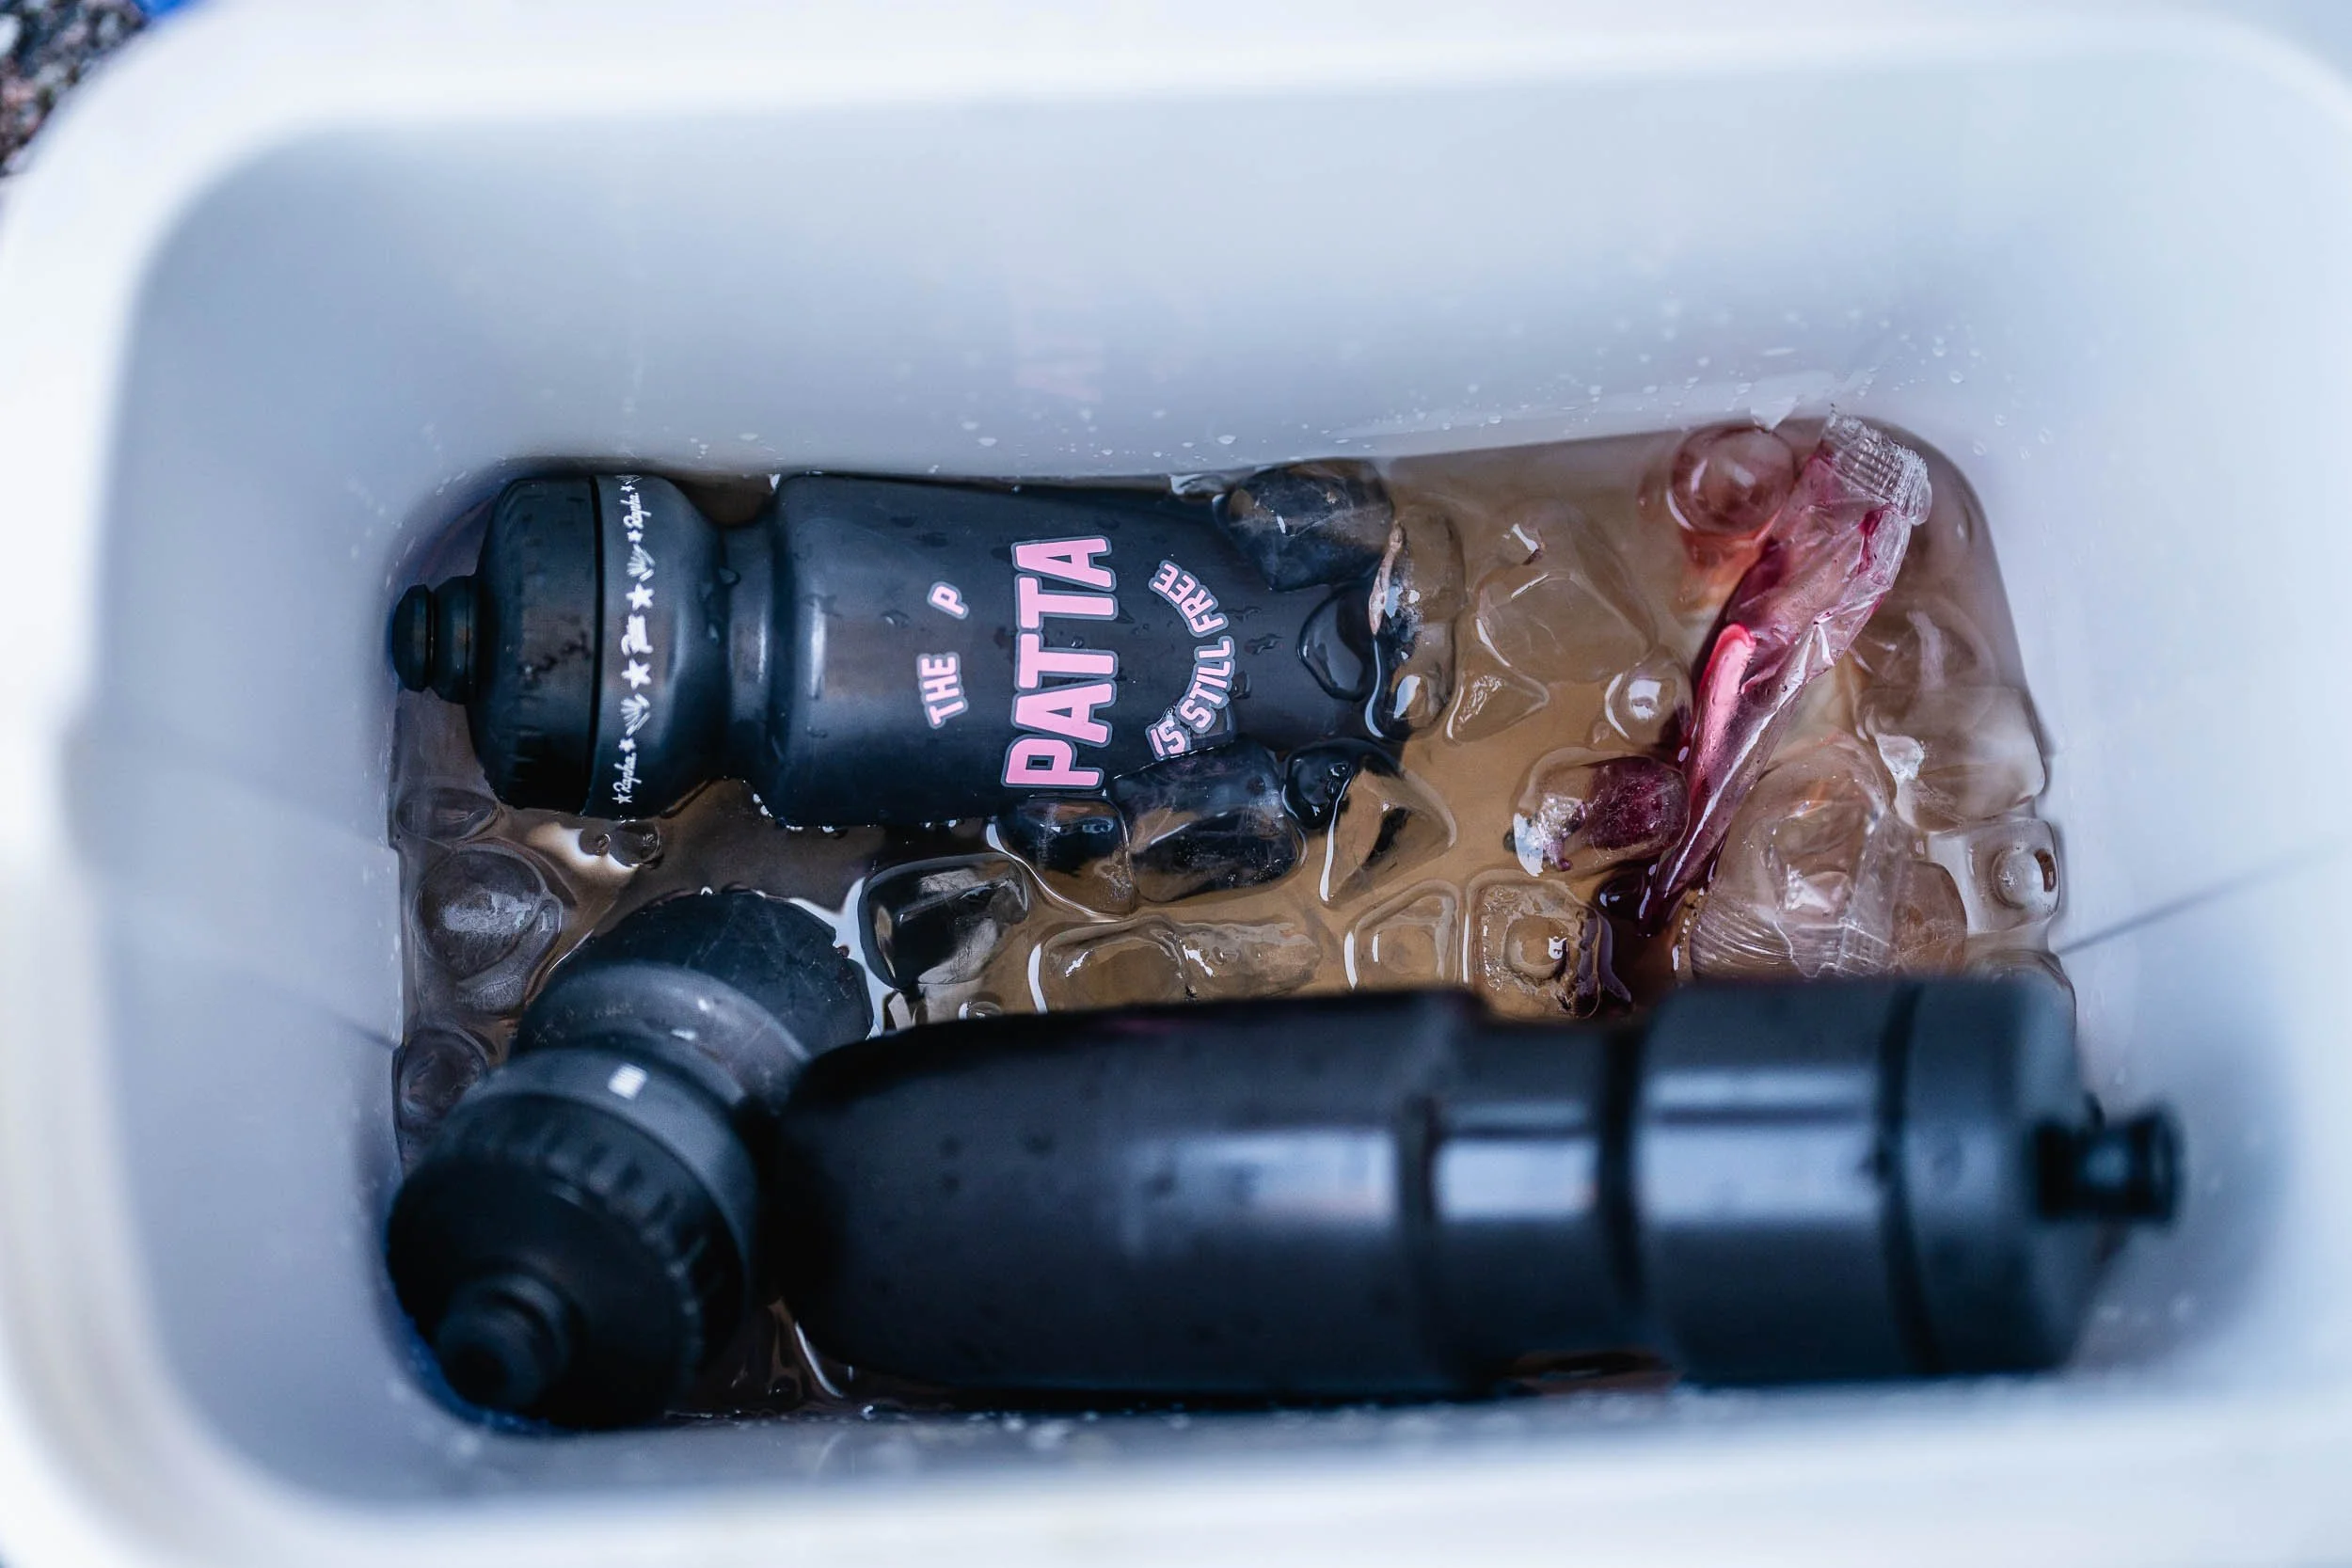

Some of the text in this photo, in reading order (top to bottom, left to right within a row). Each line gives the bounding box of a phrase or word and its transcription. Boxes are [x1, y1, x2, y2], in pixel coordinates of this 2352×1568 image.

[919, 583, 966, 727] THE P
[1004, 536, 1116, 787] PATTA
[1149, 562, 1232, 757] IS STILL FREE
